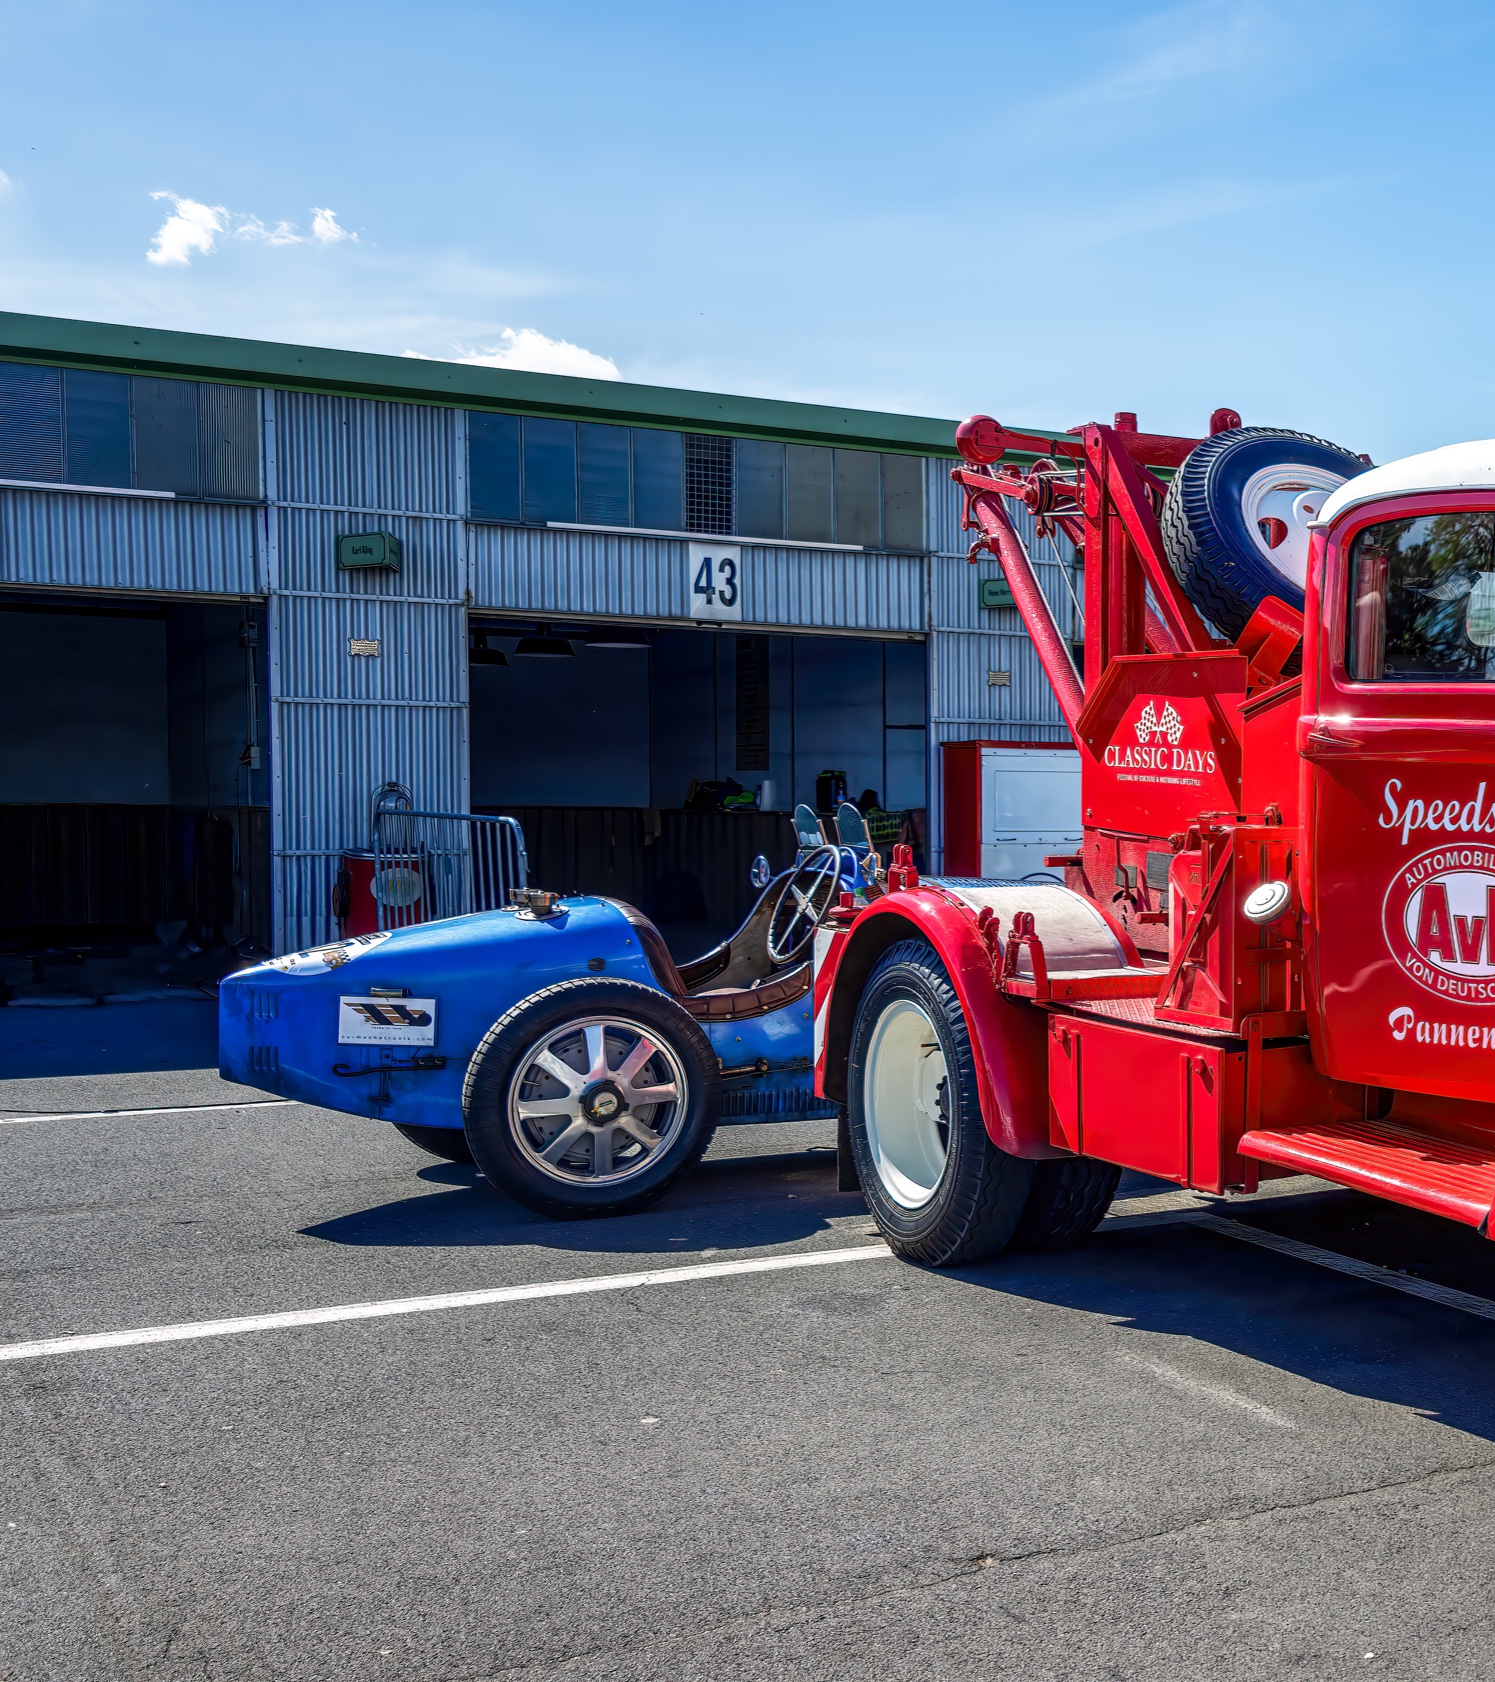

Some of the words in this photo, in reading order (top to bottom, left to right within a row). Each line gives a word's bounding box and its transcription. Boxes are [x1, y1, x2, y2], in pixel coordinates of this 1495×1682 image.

[694, 556, 738, 608] 43
[1104, 745, 1168, 770] CLASSIC
[1171, 747, 1216, 774] DAYS
[1404, 951, 1434, 985] VON
